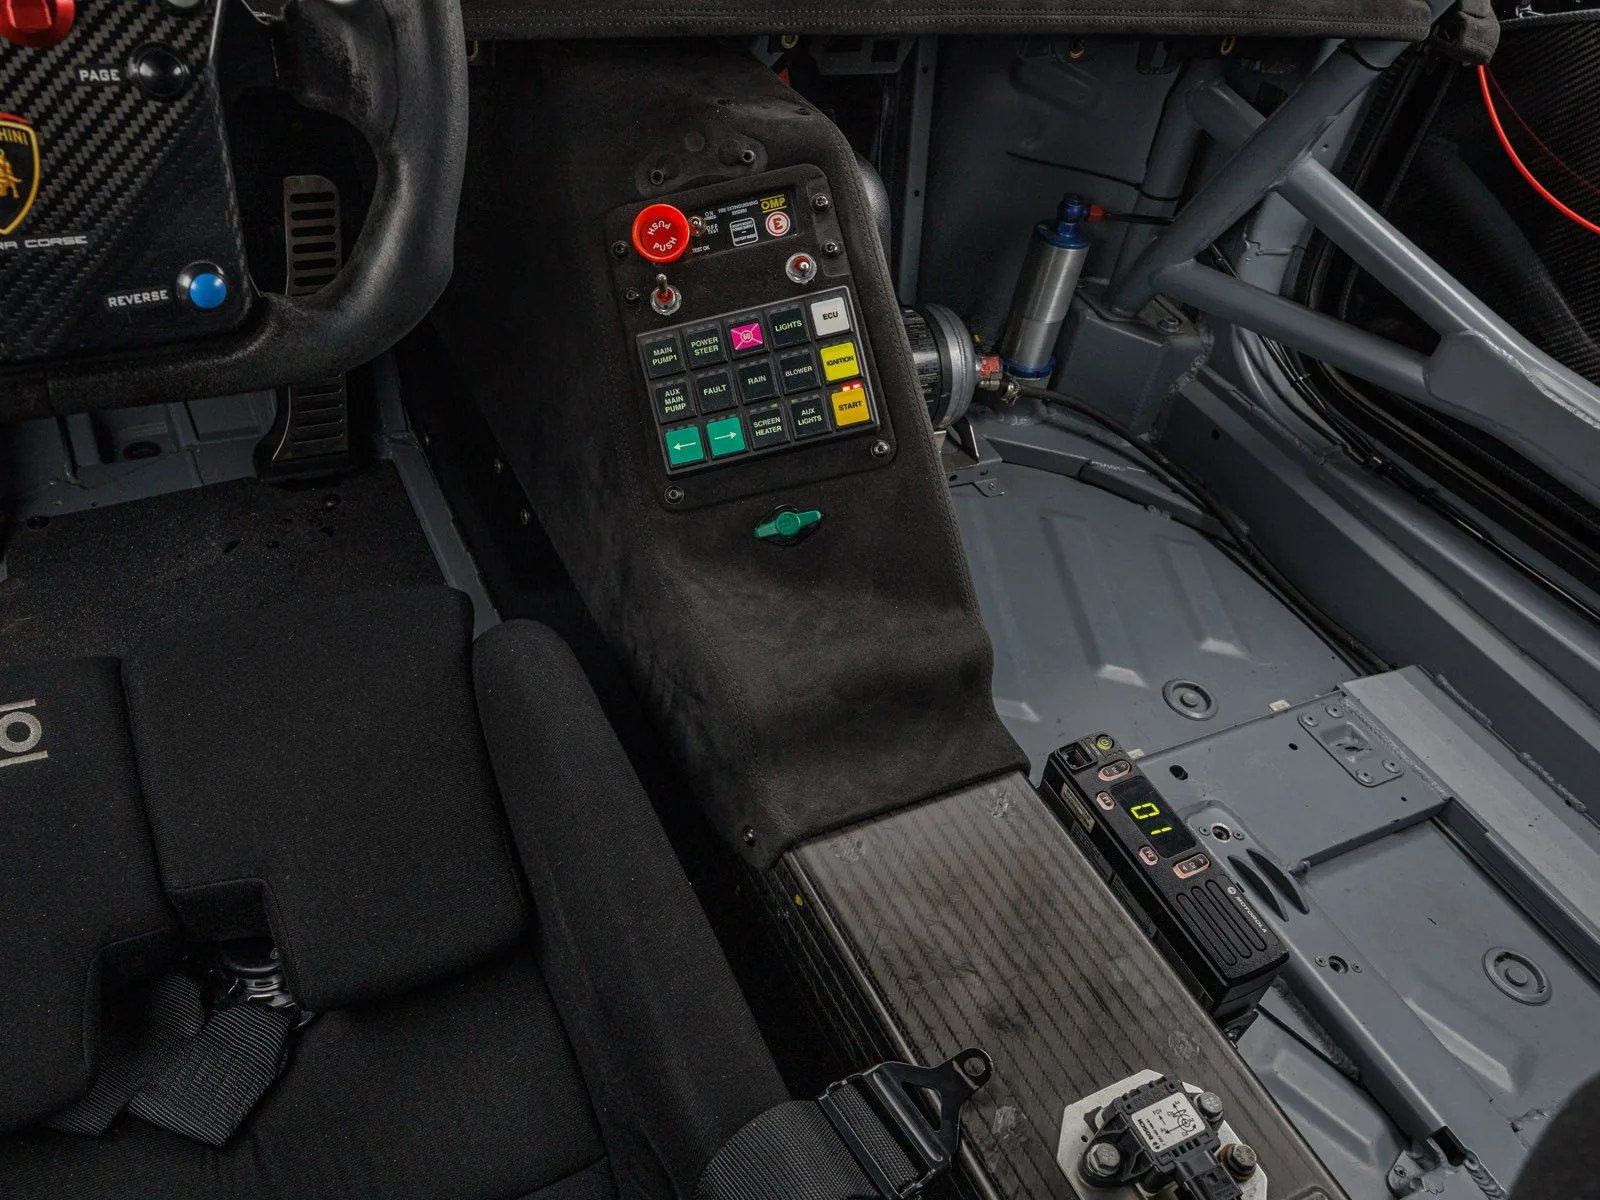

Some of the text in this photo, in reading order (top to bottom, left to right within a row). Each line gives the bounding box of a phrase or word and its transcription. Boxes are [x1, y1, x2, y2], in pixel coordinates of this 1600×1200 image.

[79, 69, 121, 82] PAGE
[761, 197, 786, 210] OMP
[732, 208, 748, 216] SYSTEM
[647, 220, 672, 236] PUSH
[772, 218, 783, 231] E
[24, 235, 88, 248] CORSE
[652, 237, 677, 252] PUSH
[107, 290, 169, 307] REVERSE
[822, 311, 839, 320] ECU
[775, 319, 803, 332] LIGHTS
[690, 336, 719, 348] POWER
[653, 346, 673, 356] MAIN
[694, 345, 719, 356] STEER
[652, 355, 677, 365] PUMP1
[826, 355, 854, 366] IGNITION
[785, 365, 813, 377] BLOWER
[747, 375, 767, 385] RAIN
[664, 388, 680, 397] AUX
[703, 384, 727, 395] FAULT
[664, 395, 684, 405] MAIN
[838, 400, 862, 411] START
[665, 403, 687, 413] PUMP
[801, 408, 816, 416] AUX
[753, 416, 781, 428] SCREEN
[797, 415, 822, 426] LIGHTS
[755, 426, 783, 436] HEATER
[1235, 896, 1267, 933] MOTOROLA
[1137, 1118, 1154, 1140] BOSCH
